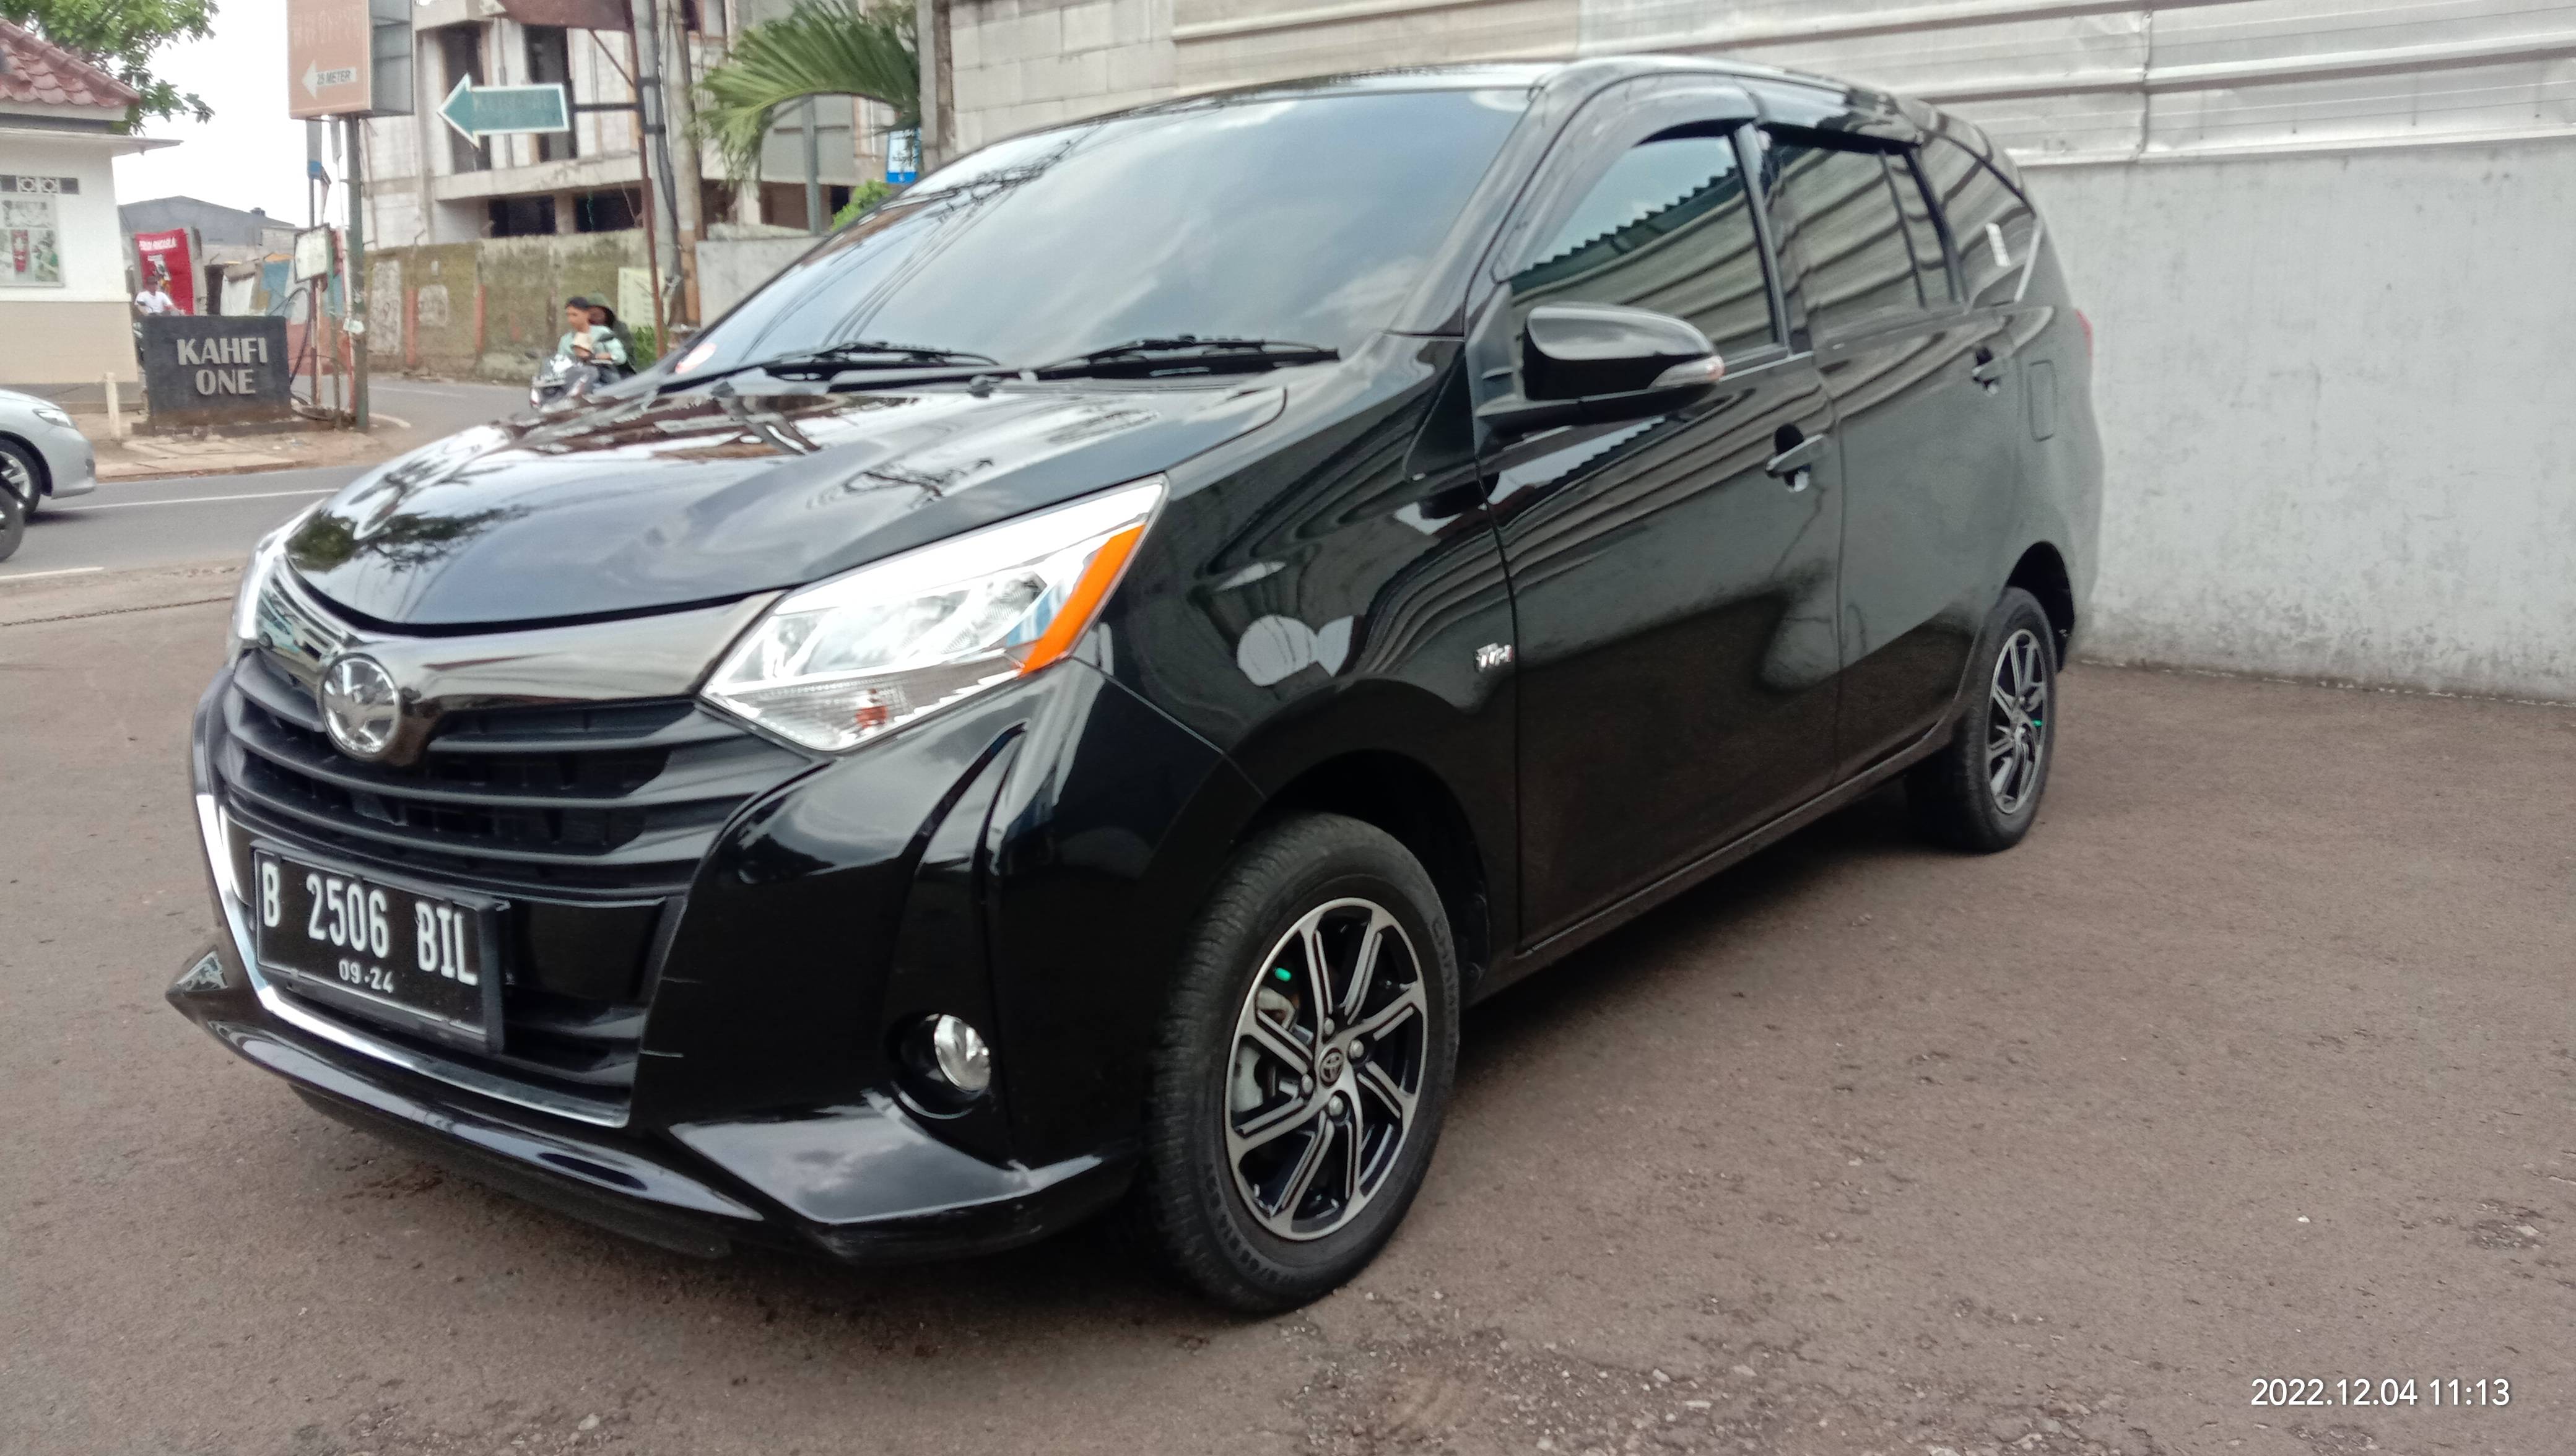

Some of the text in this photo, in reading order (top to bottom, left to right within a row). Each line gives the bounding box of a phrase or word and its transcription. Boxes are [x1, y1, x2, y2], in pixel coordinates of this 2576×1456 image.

[326, 70, 351, 84] METER
[176, 337, 268, 366] KAHFI
[195, 368, 256, 397] ONE
[261, 862, 478, 986] B 2506 BIL
